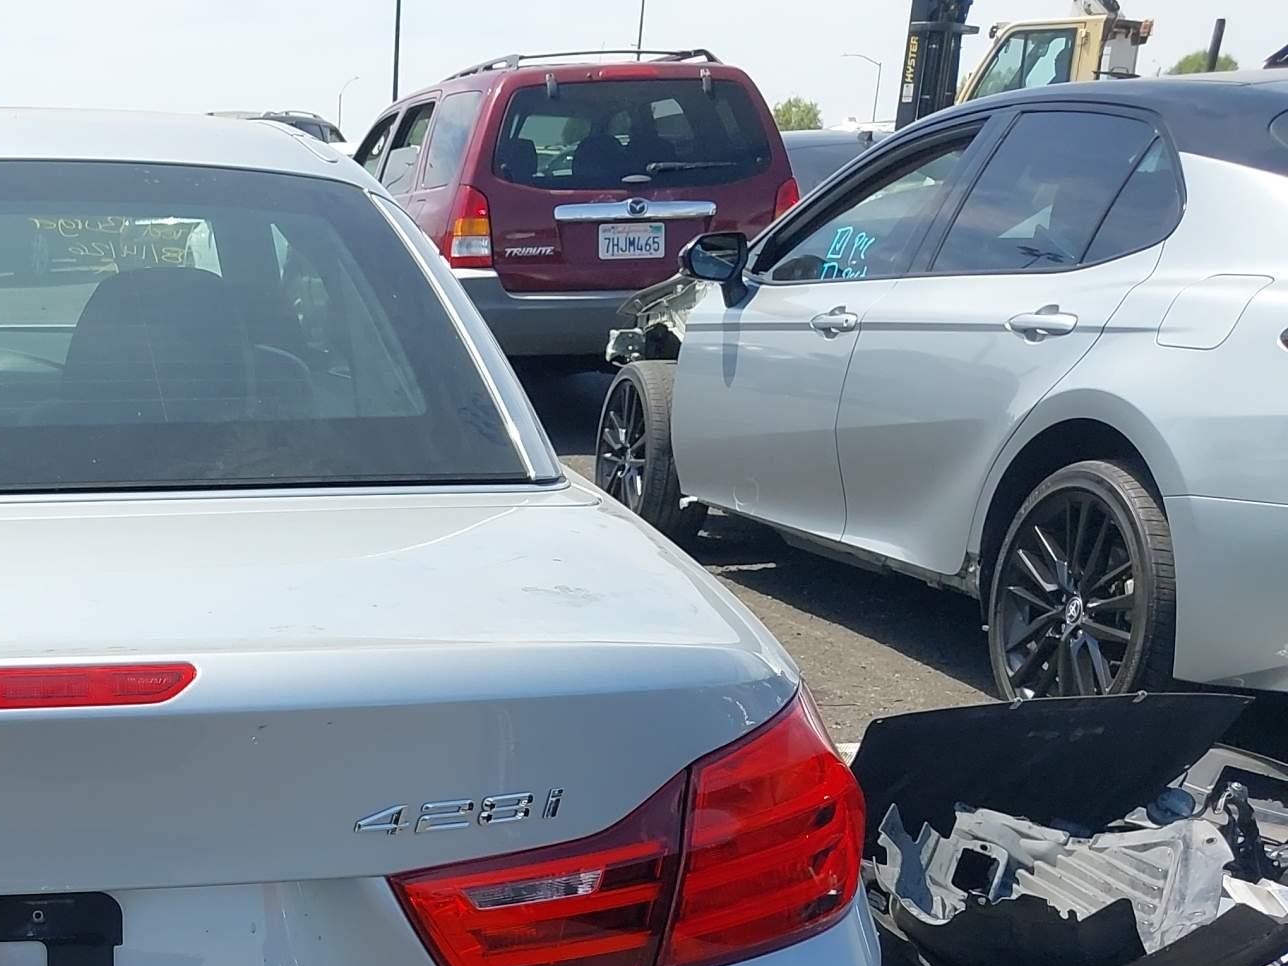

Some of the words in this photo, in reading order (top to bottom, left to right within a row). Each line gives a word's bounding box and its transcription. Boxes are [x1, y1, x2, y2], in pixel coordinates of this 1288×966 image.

[905, 36, 919, 82] HYSTER
[504, 246, 555, 258] TRIBUTE
[603, 236, 660, 253] 7HJM465
[353, 787, 564, 836] 428i
